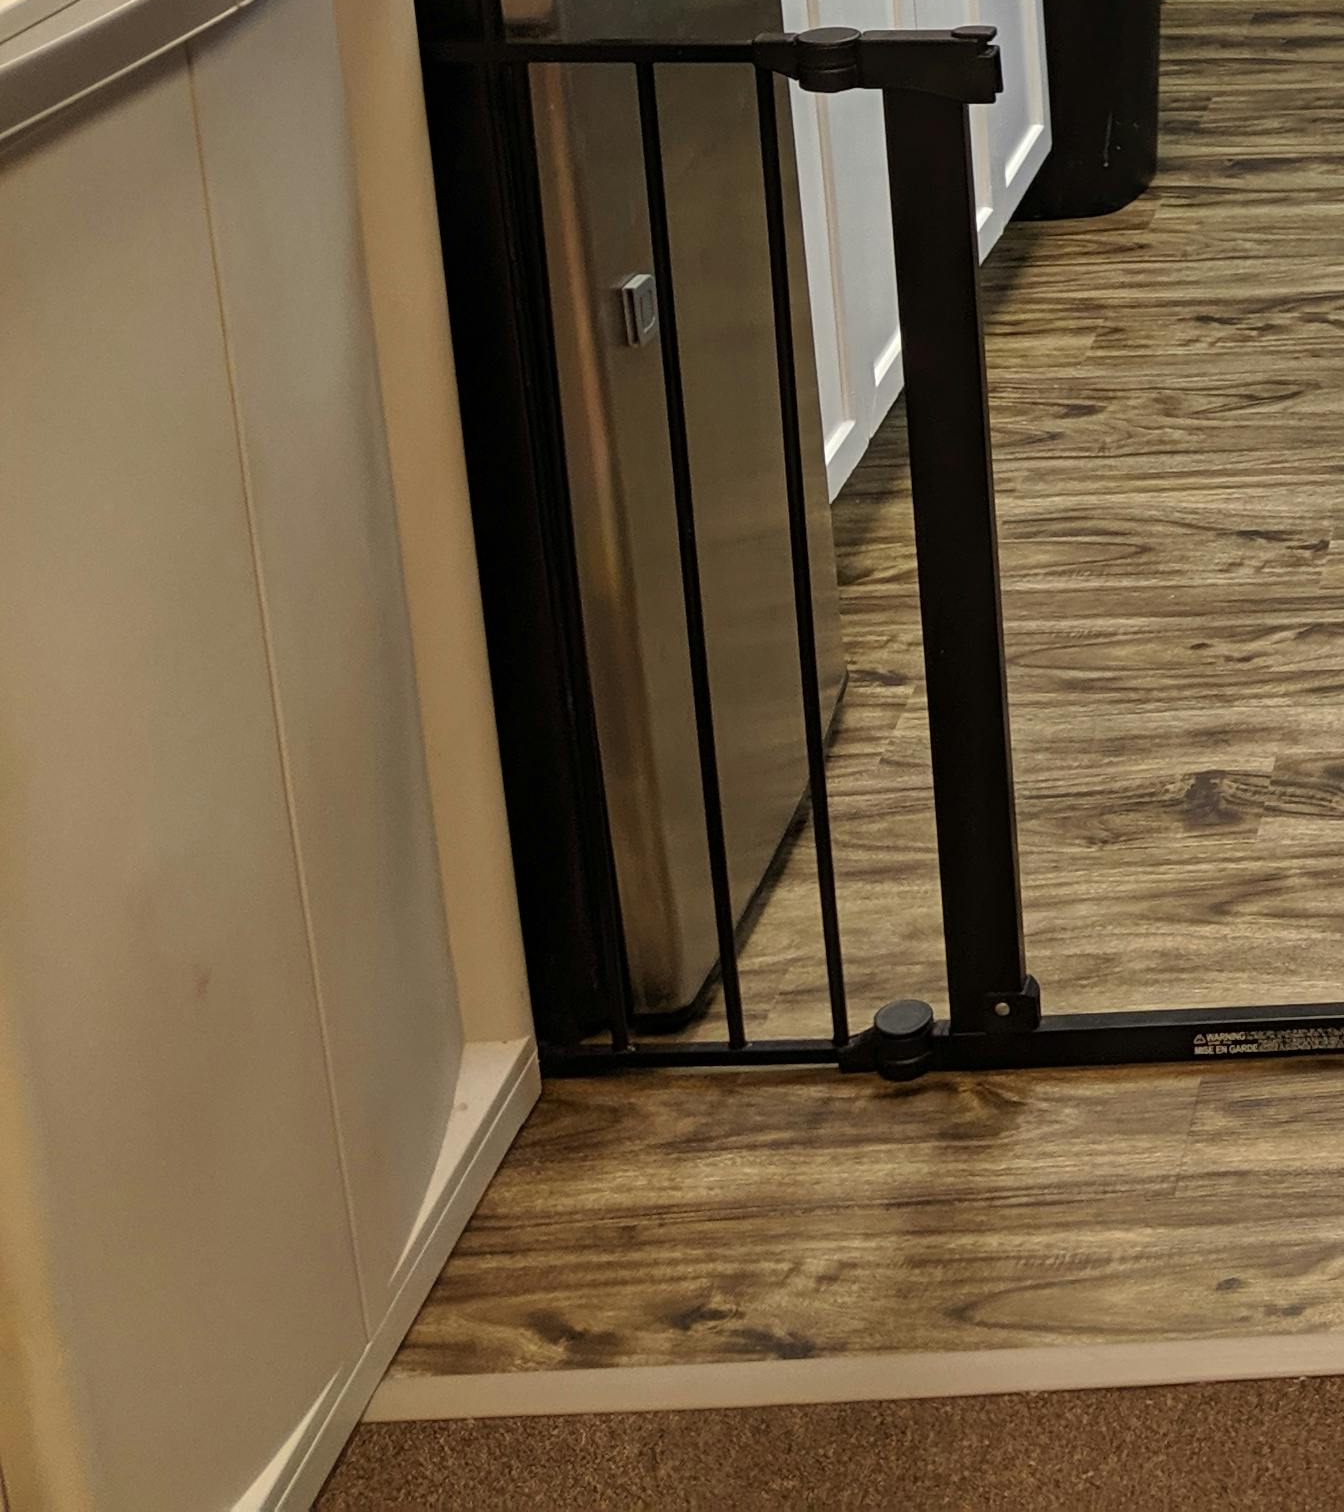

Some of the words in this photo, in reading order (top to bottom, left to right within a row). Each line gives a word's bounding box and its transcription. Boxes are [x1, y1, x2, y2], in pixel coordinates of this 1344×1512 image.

[1205, 1031, 1247, 1042] WARNING
[1193, 1045, 1215, 1055] MISE
[1215, 1045, 1228, 1055] EN
[1228, 1043, 1258, 1055] GARDE
